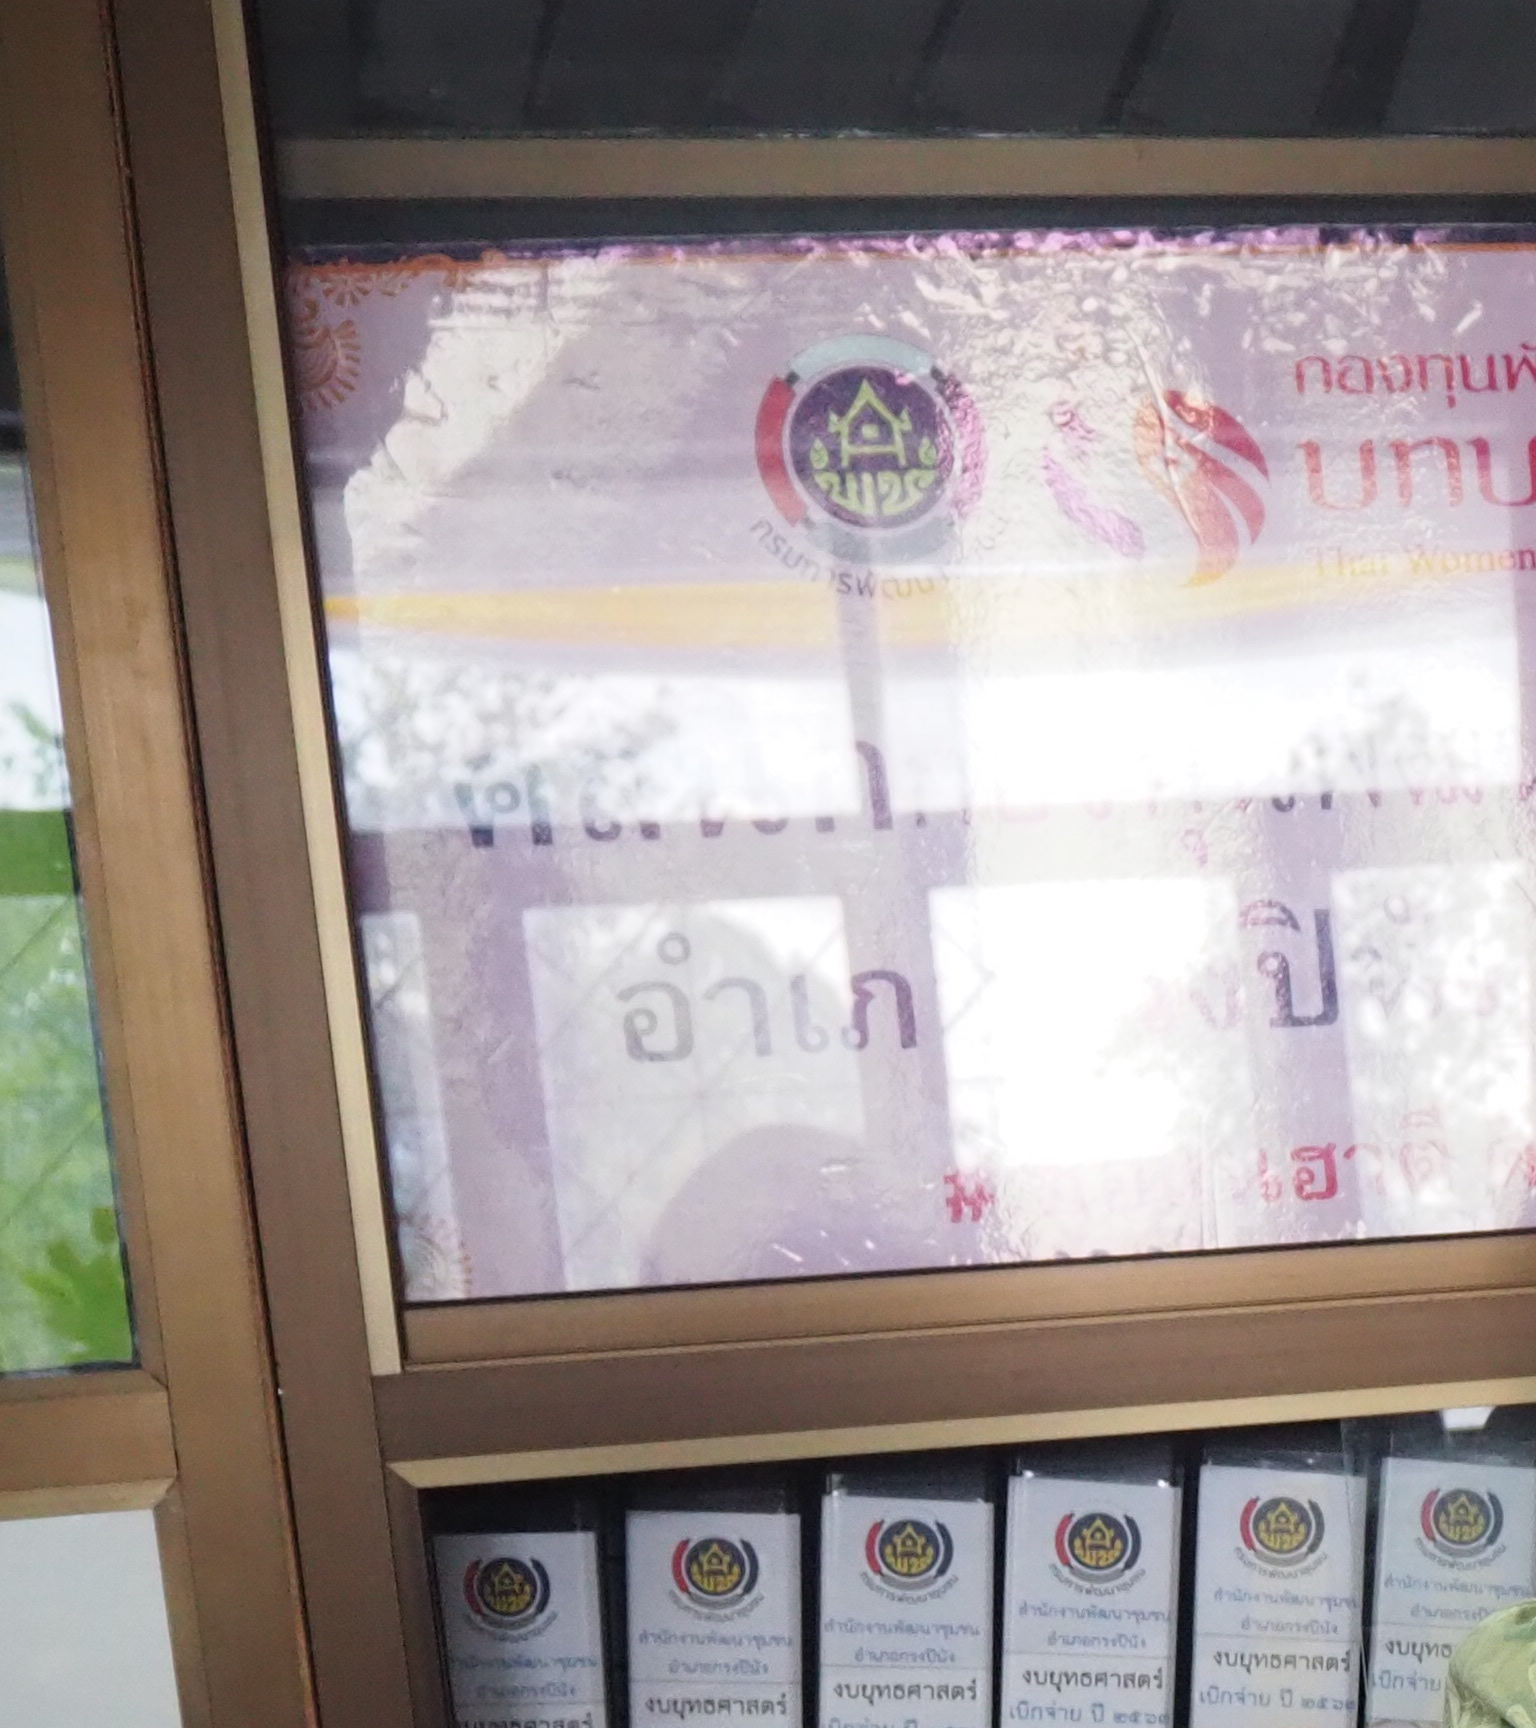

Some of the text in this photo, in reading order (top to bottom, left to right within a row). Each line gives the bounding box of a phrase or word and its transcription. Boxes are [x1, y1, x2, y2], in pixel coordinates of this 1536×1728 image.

[1212, 1646, 1353, 1678] งบยุทธศาสตร์
[1384, 1637, 1455, 1667] งบยุทธ
[831, 1675, 980, 1708] งบยุทธศาสตร์
[1021, 1664, 1165, 1694] งบยุทธศาสตร์
[1008, 1699, 1083, 1724] เบิกจ่าย
